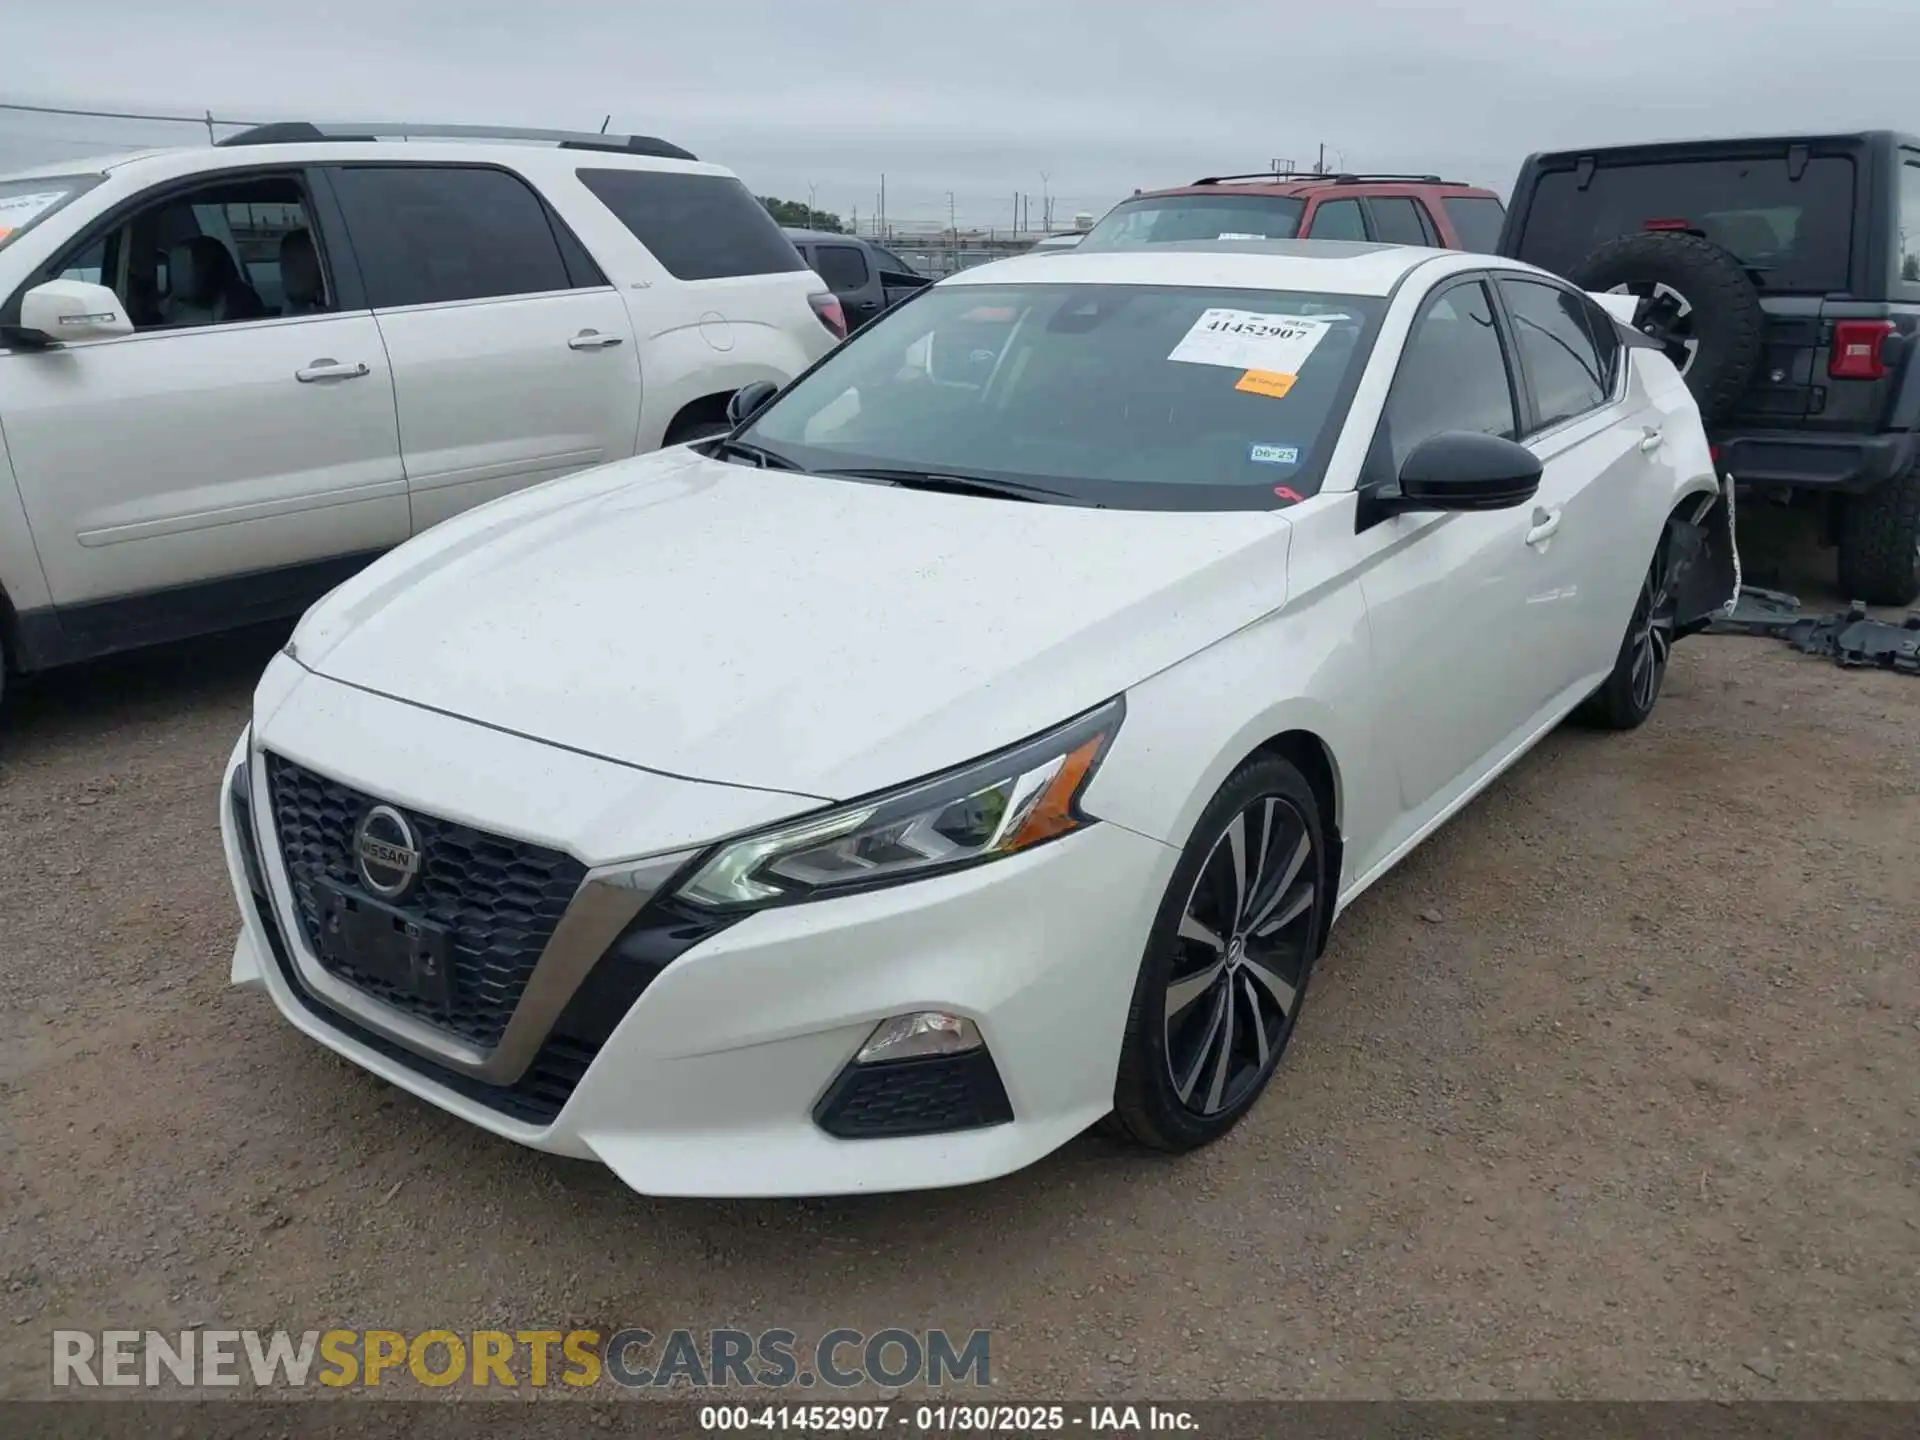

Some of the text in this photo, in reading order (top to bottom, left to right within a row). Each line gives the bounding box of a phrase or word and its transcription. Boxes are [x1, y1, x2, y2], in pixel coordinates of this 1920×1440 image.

[1207, 320, 1307, 340] 41452907
[1255, 449, 1294, 460] 06-25
[361, 838, 409, 865] NISSAN
